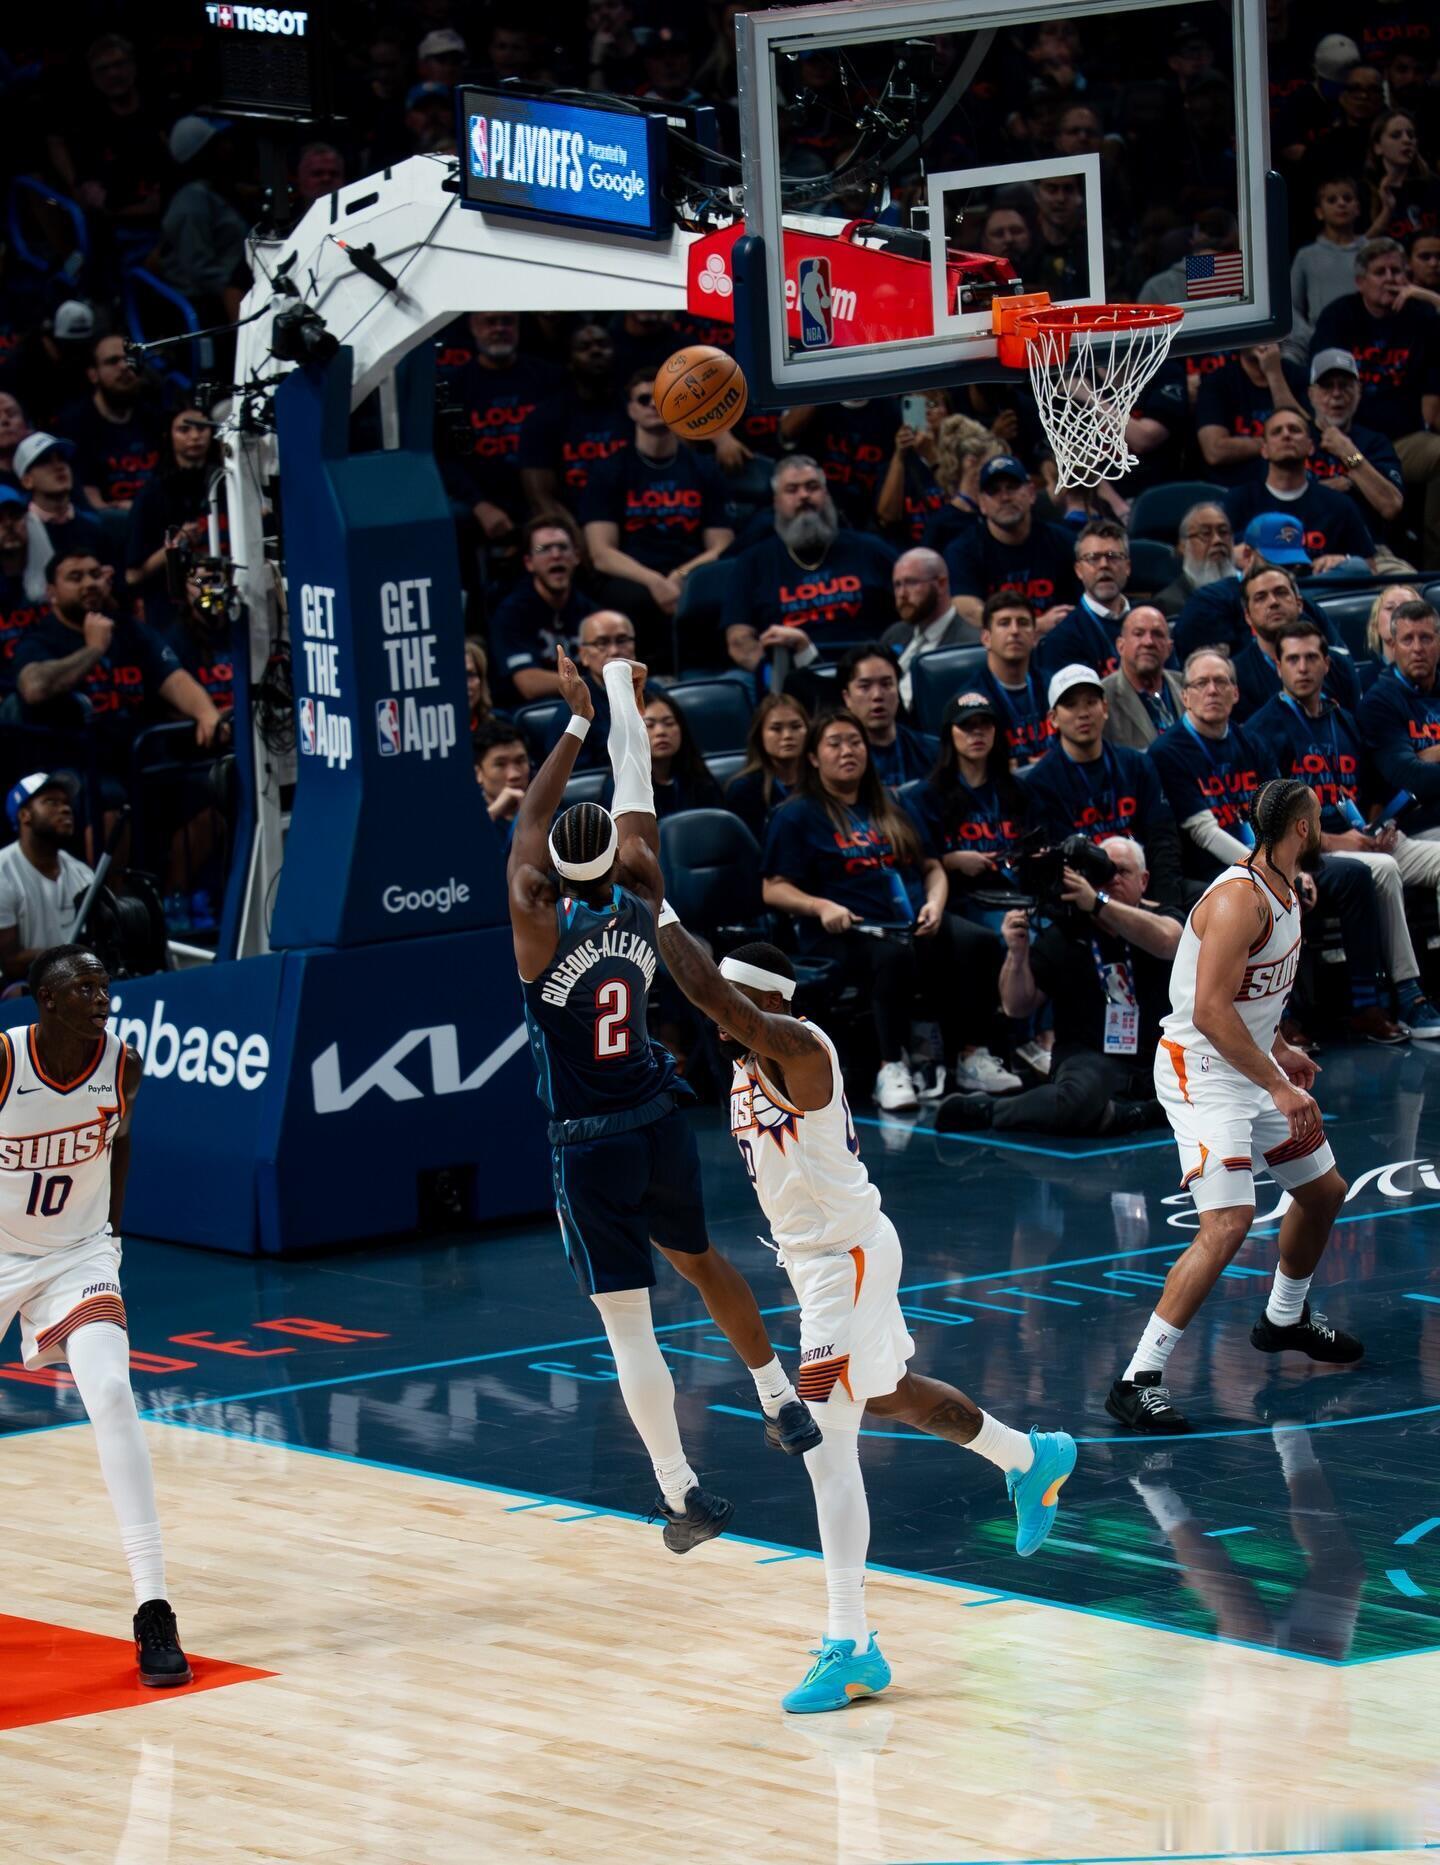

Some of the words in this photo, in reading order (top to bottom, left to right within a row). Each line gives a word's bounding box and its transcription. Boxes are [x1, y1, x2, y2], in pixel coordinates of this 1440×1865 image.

[233, 5, 308, 36] TISSOT
[489, 119, 584, 193] PLAYOFFS
[588, 162, 645, 202] Google
[806, 327, 822, 342] NBA
[687, 388, 740, 430] Wilson
[301, 583, 335, 640] GET
[380, 577, 432, 635] GET
[779, 575, 862, 605] LOUD
[303, 640, 342, 698] THE
[383, 634, 440, 692] THE
[316, 700, 353, 771] App
[404, 696, 457, 761] App
[383, 877, 470, 913] Google
[107, 996, 269, 1091] inbase
[595, 977, 631, 1060] 2
[88, 1085, 113, 1095] PayPal
[26, 1172, 73, 1217] 10
